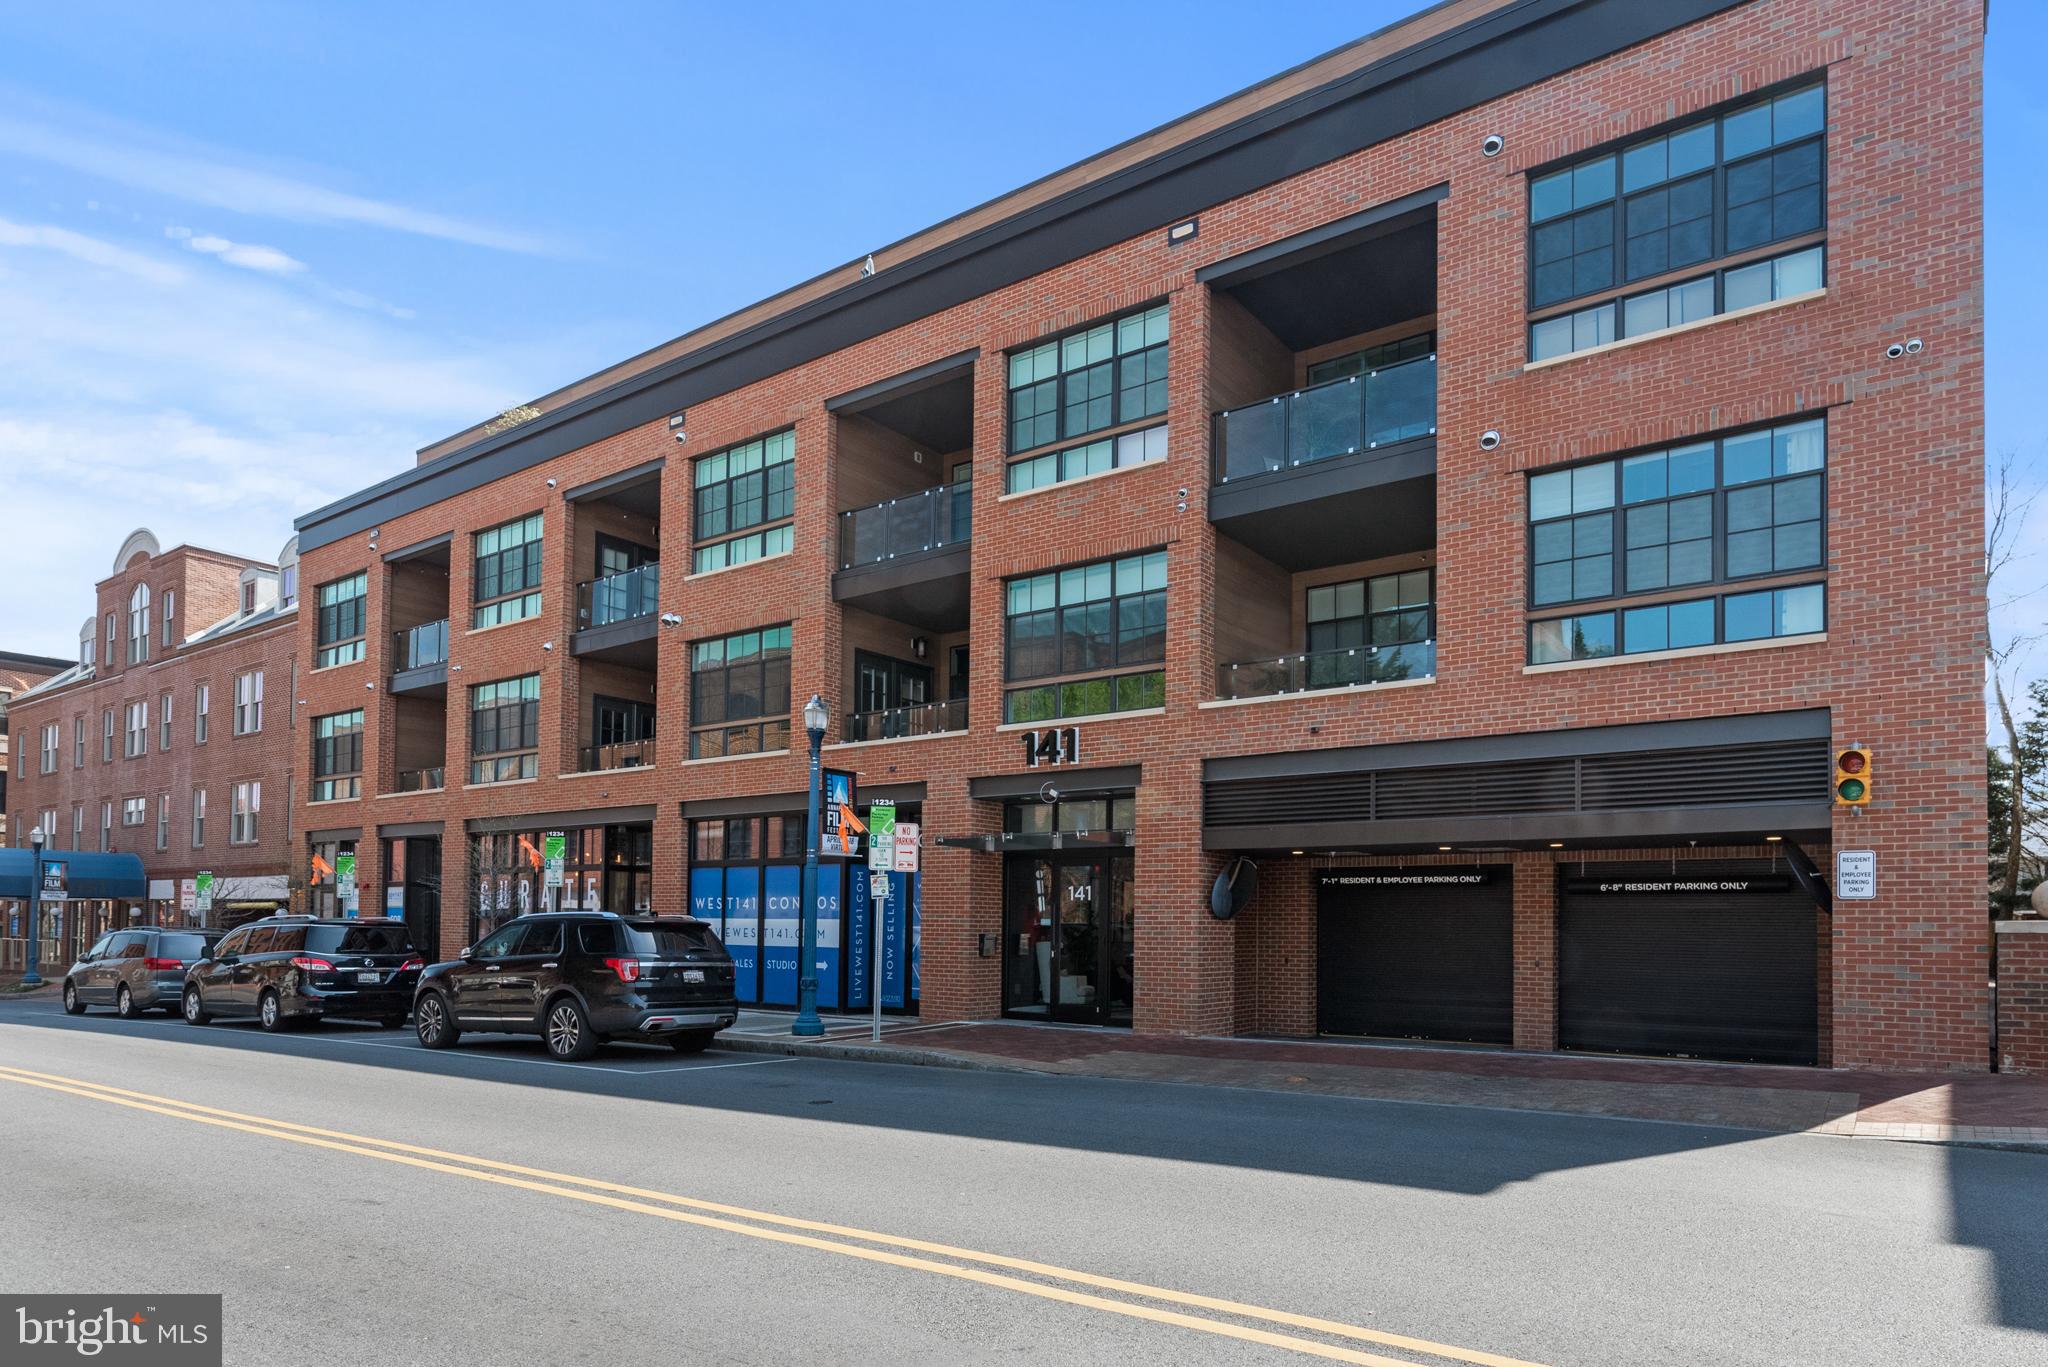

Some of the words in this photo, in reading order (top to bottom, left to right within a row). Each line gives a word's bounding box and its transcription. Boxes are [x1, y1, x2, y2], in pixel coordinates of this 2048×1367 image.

[1021, 727, 1079, 767] 141
[902, 827, 911, 836] NO
[871, 835, 877, 846] 2
[896, 837, 917, 846] PARKING
[44, 879, 61, 888] FILM
[1339, 876, 1376, 884] RESIDENT
[1376, 876, 1382, 884] &
[1383, 876, 1423, 884] EMPLOYEE
[1423, 875, 1458, 883] PARKING
[1459, 875, 1482, 883] ONLY
[1624, 883, 1672, 891] RESIDENT
[1674, 882, 1718, 890] PARKING
[1720, 882, 1748, 890] ONLY
[1068, 885, 1092, 901] 141
[695, 896, 756, 910] WEST141
[769, 896, 837, 910] CONOS
[887, 882, 895, 941] SELLING
[854, 871, 864, 999] LIVEWEST141.COM
[734, 959, 753, 968] ALES
[766, 960, 797, 970] STUDIO
[886, 947, 894, 980] NOW
